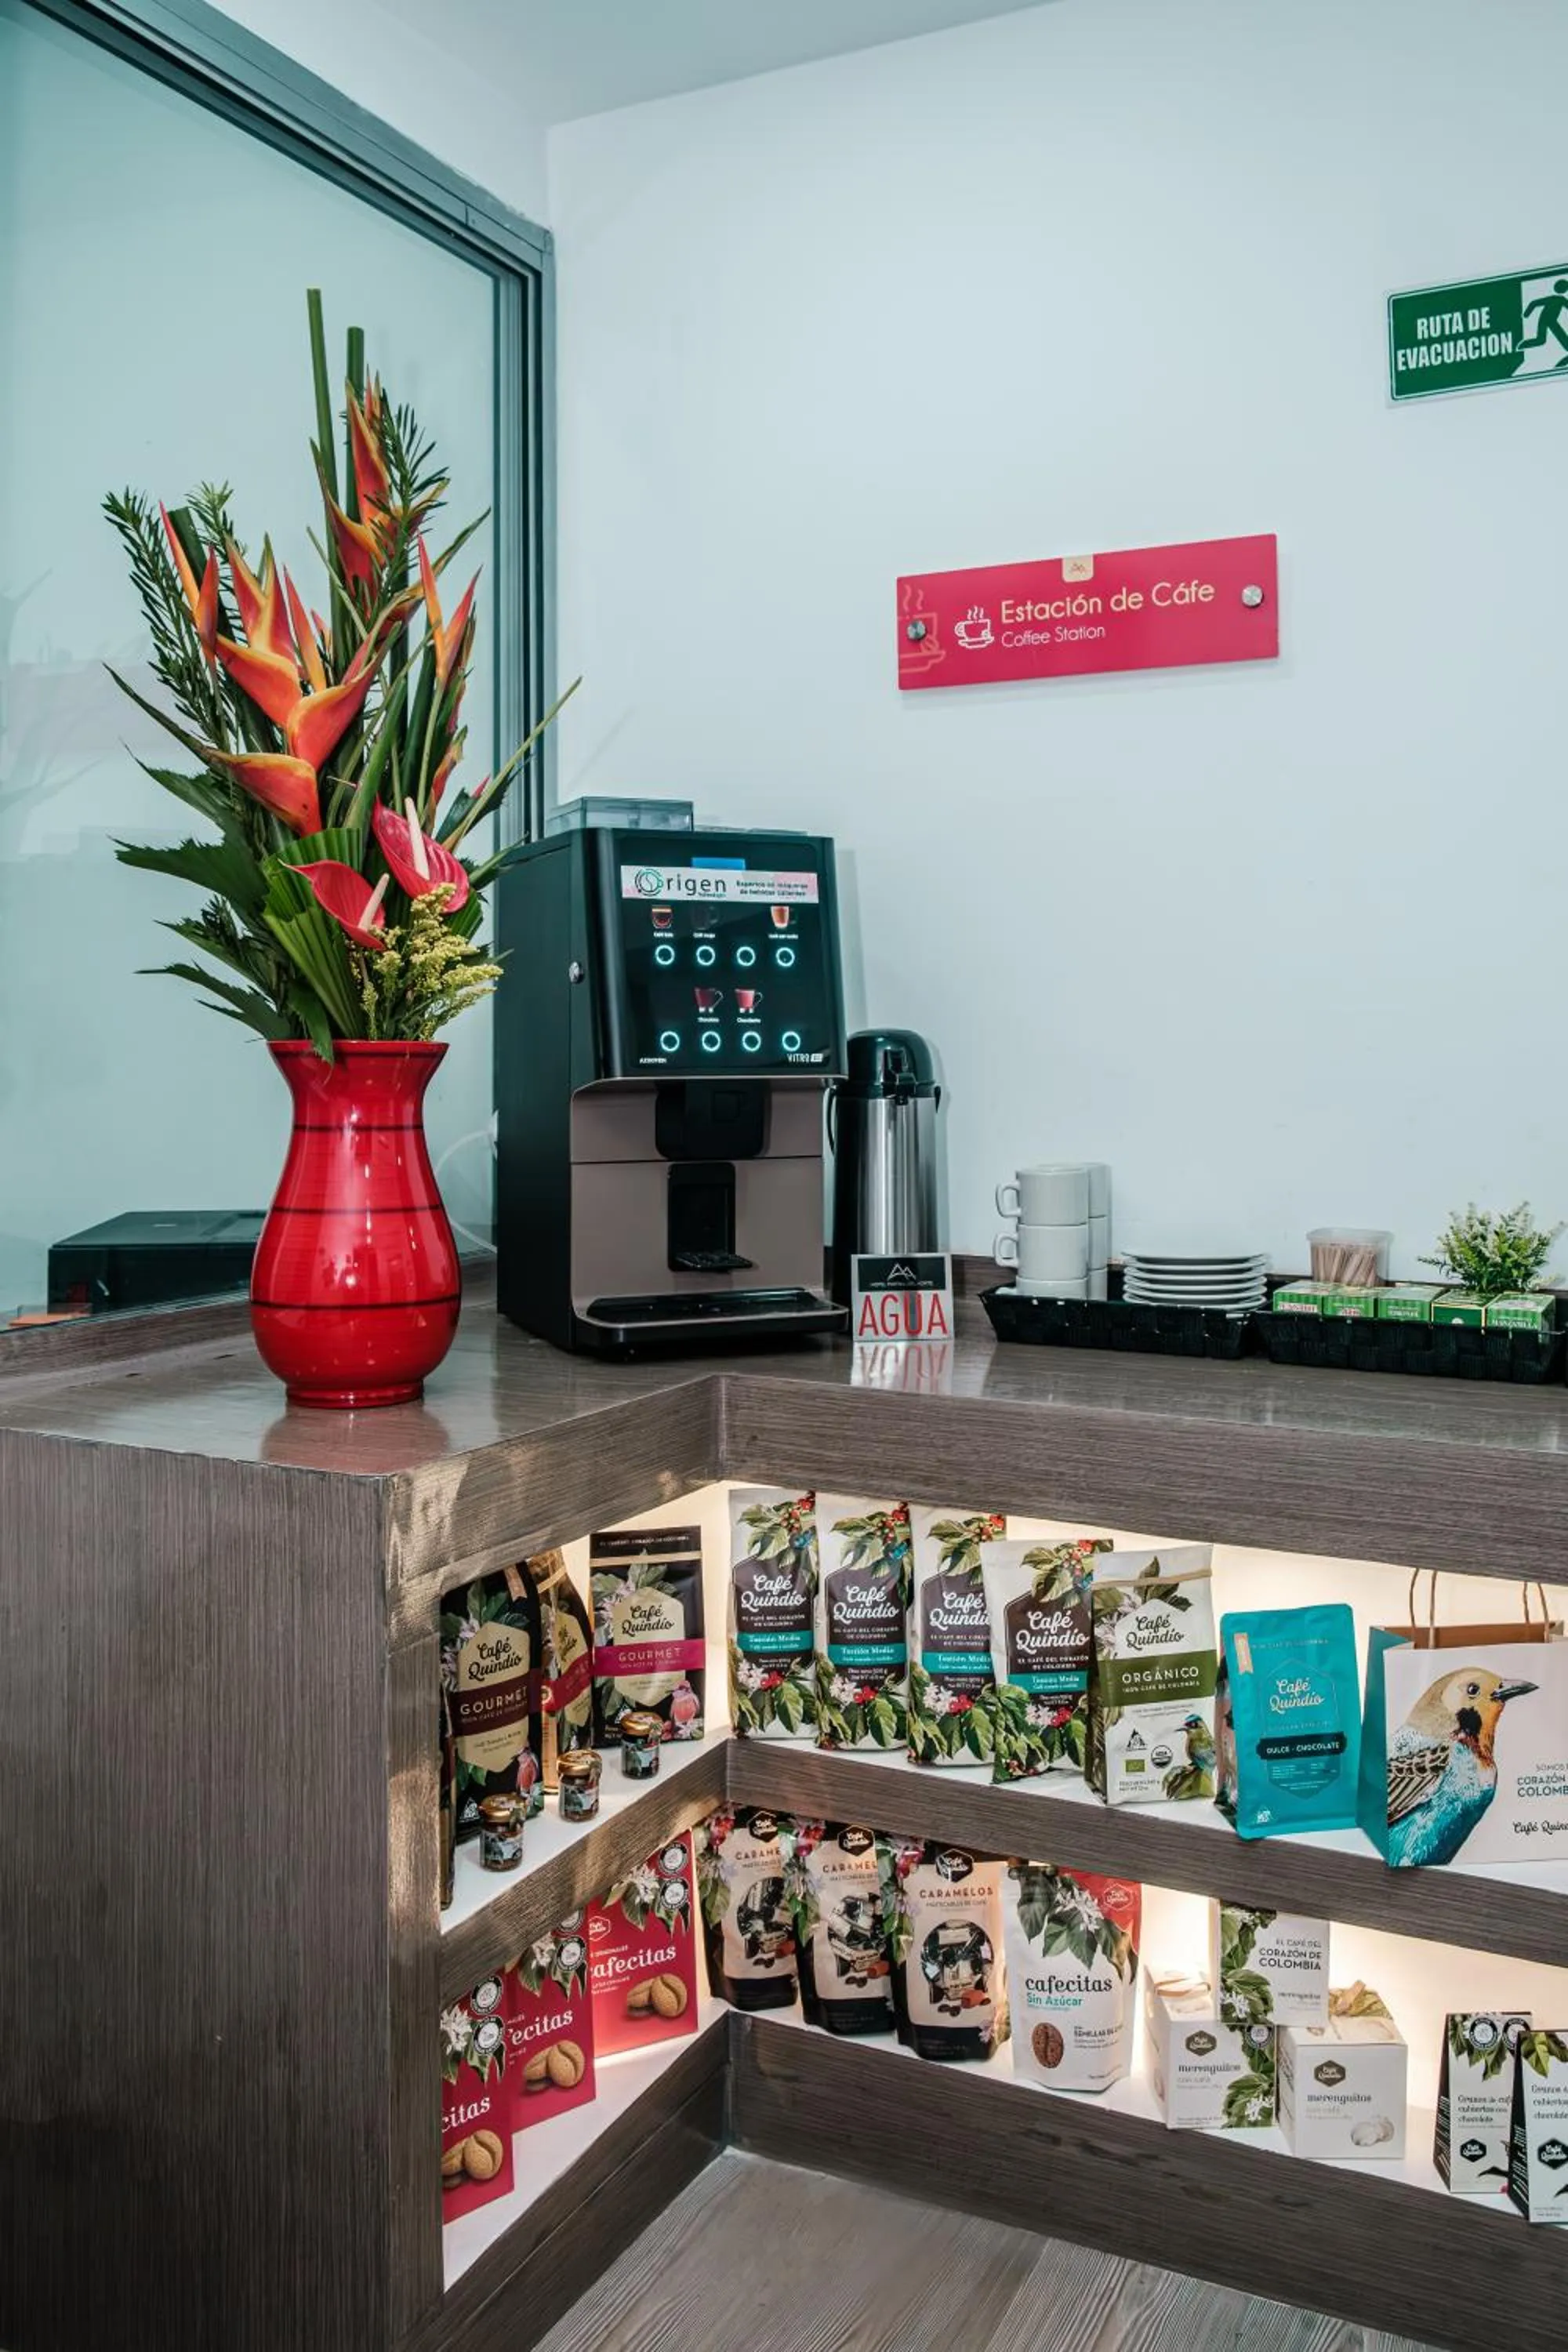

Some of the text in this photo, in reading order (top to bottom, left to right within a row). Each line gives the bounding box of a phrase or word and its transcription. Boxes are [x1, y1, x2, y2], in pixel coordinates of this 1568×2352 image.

[1417, 307, 1490, 339] RUTA DE
[1396, 331, 1512, 372] EVACUACION
[1001, 580, 1214, 624] Estación de Cáfe
[1001, 626, 1105, 648] Coffee Station
[858, 1292, 948, 1337] AGUA
[753, 1574, 793, 1595] Café
[741, 1591, 807, 1613] Quindío
[846, 1585, 887, 1606] Café
[942, 1592, 984, 1613] Café
[630, 1605, 663, 1621] Café
[833, 1602, 900, 1624] Quindío
[1028, 1610, 1073, 1634] Café
[1135, 1614, 1171, 1633] Café
[621, 1617, 674, 1637] Quindío
[477, 1637, 511, 1661] Café
[1016, 1628, 1090, 1655] Quindío
[1126, 1628, 1185, 1651] Quindío
[619, 1647, 682, 1662] GOURMET
[468, 1653, 522, 1682] Quindío
[1122, 1666, 1199, 1684] ORGÁNICO
[1276, 1677, 1312, 1697] Café
[460, 1686, 528, 1715] GOURMET
[1269, 1690, 1326, 1715] Quindío
[1267, 1745, 1290, 1755] DULCE
[1296, 1741, 1341, 1753] CHOCOLATE
[1517, 1772, 1566, 1785] CORAZÓN
[1517, 1785, 1568, 1798] COLOMB
[1512, 1820, 1568, 1835] Café Quin
[735, 1847, 781, 1860] CARAME
[822, 1860, 877, 1873] CARAMEL
[919, 1886, 993, 1899] CARAMELOS
[1259, 1947, 1307, 1958] CORAZÓN
[1259, 1958, 1321, 1970] COLOMBIA
[1025, 1975, 1113, 1994] cafecitas
[1027, 1992, 1083, 2006] Sin Azúcar
[507, 2010, 574, 2045] ecitas
[442, 2097, 491, 2133] citas
